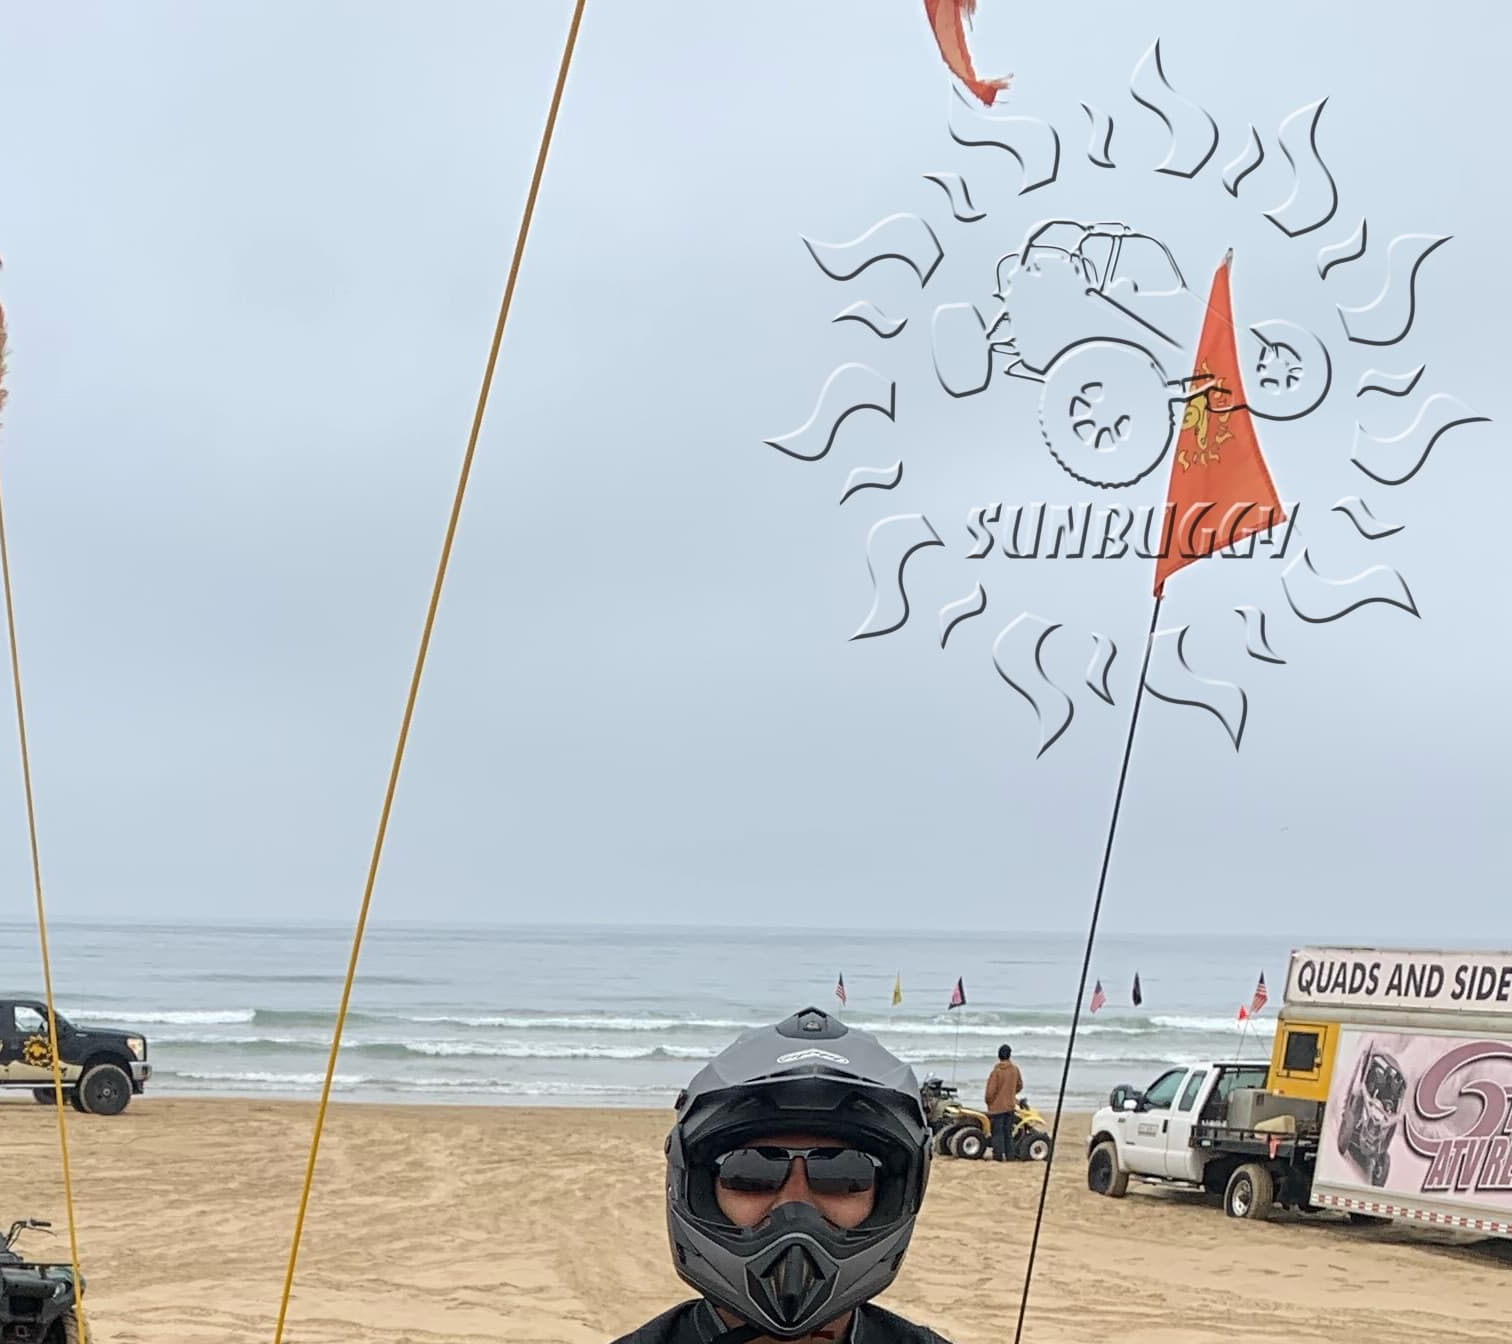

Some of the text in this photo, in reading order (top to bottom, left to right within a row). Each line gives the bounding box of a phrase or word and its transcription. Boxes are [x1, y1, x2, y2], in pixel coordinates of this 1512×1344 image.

[1298, 960, 1512, 1002] QUADS AND SIDE
[1422, 1136, 1490, 1191] ATV
